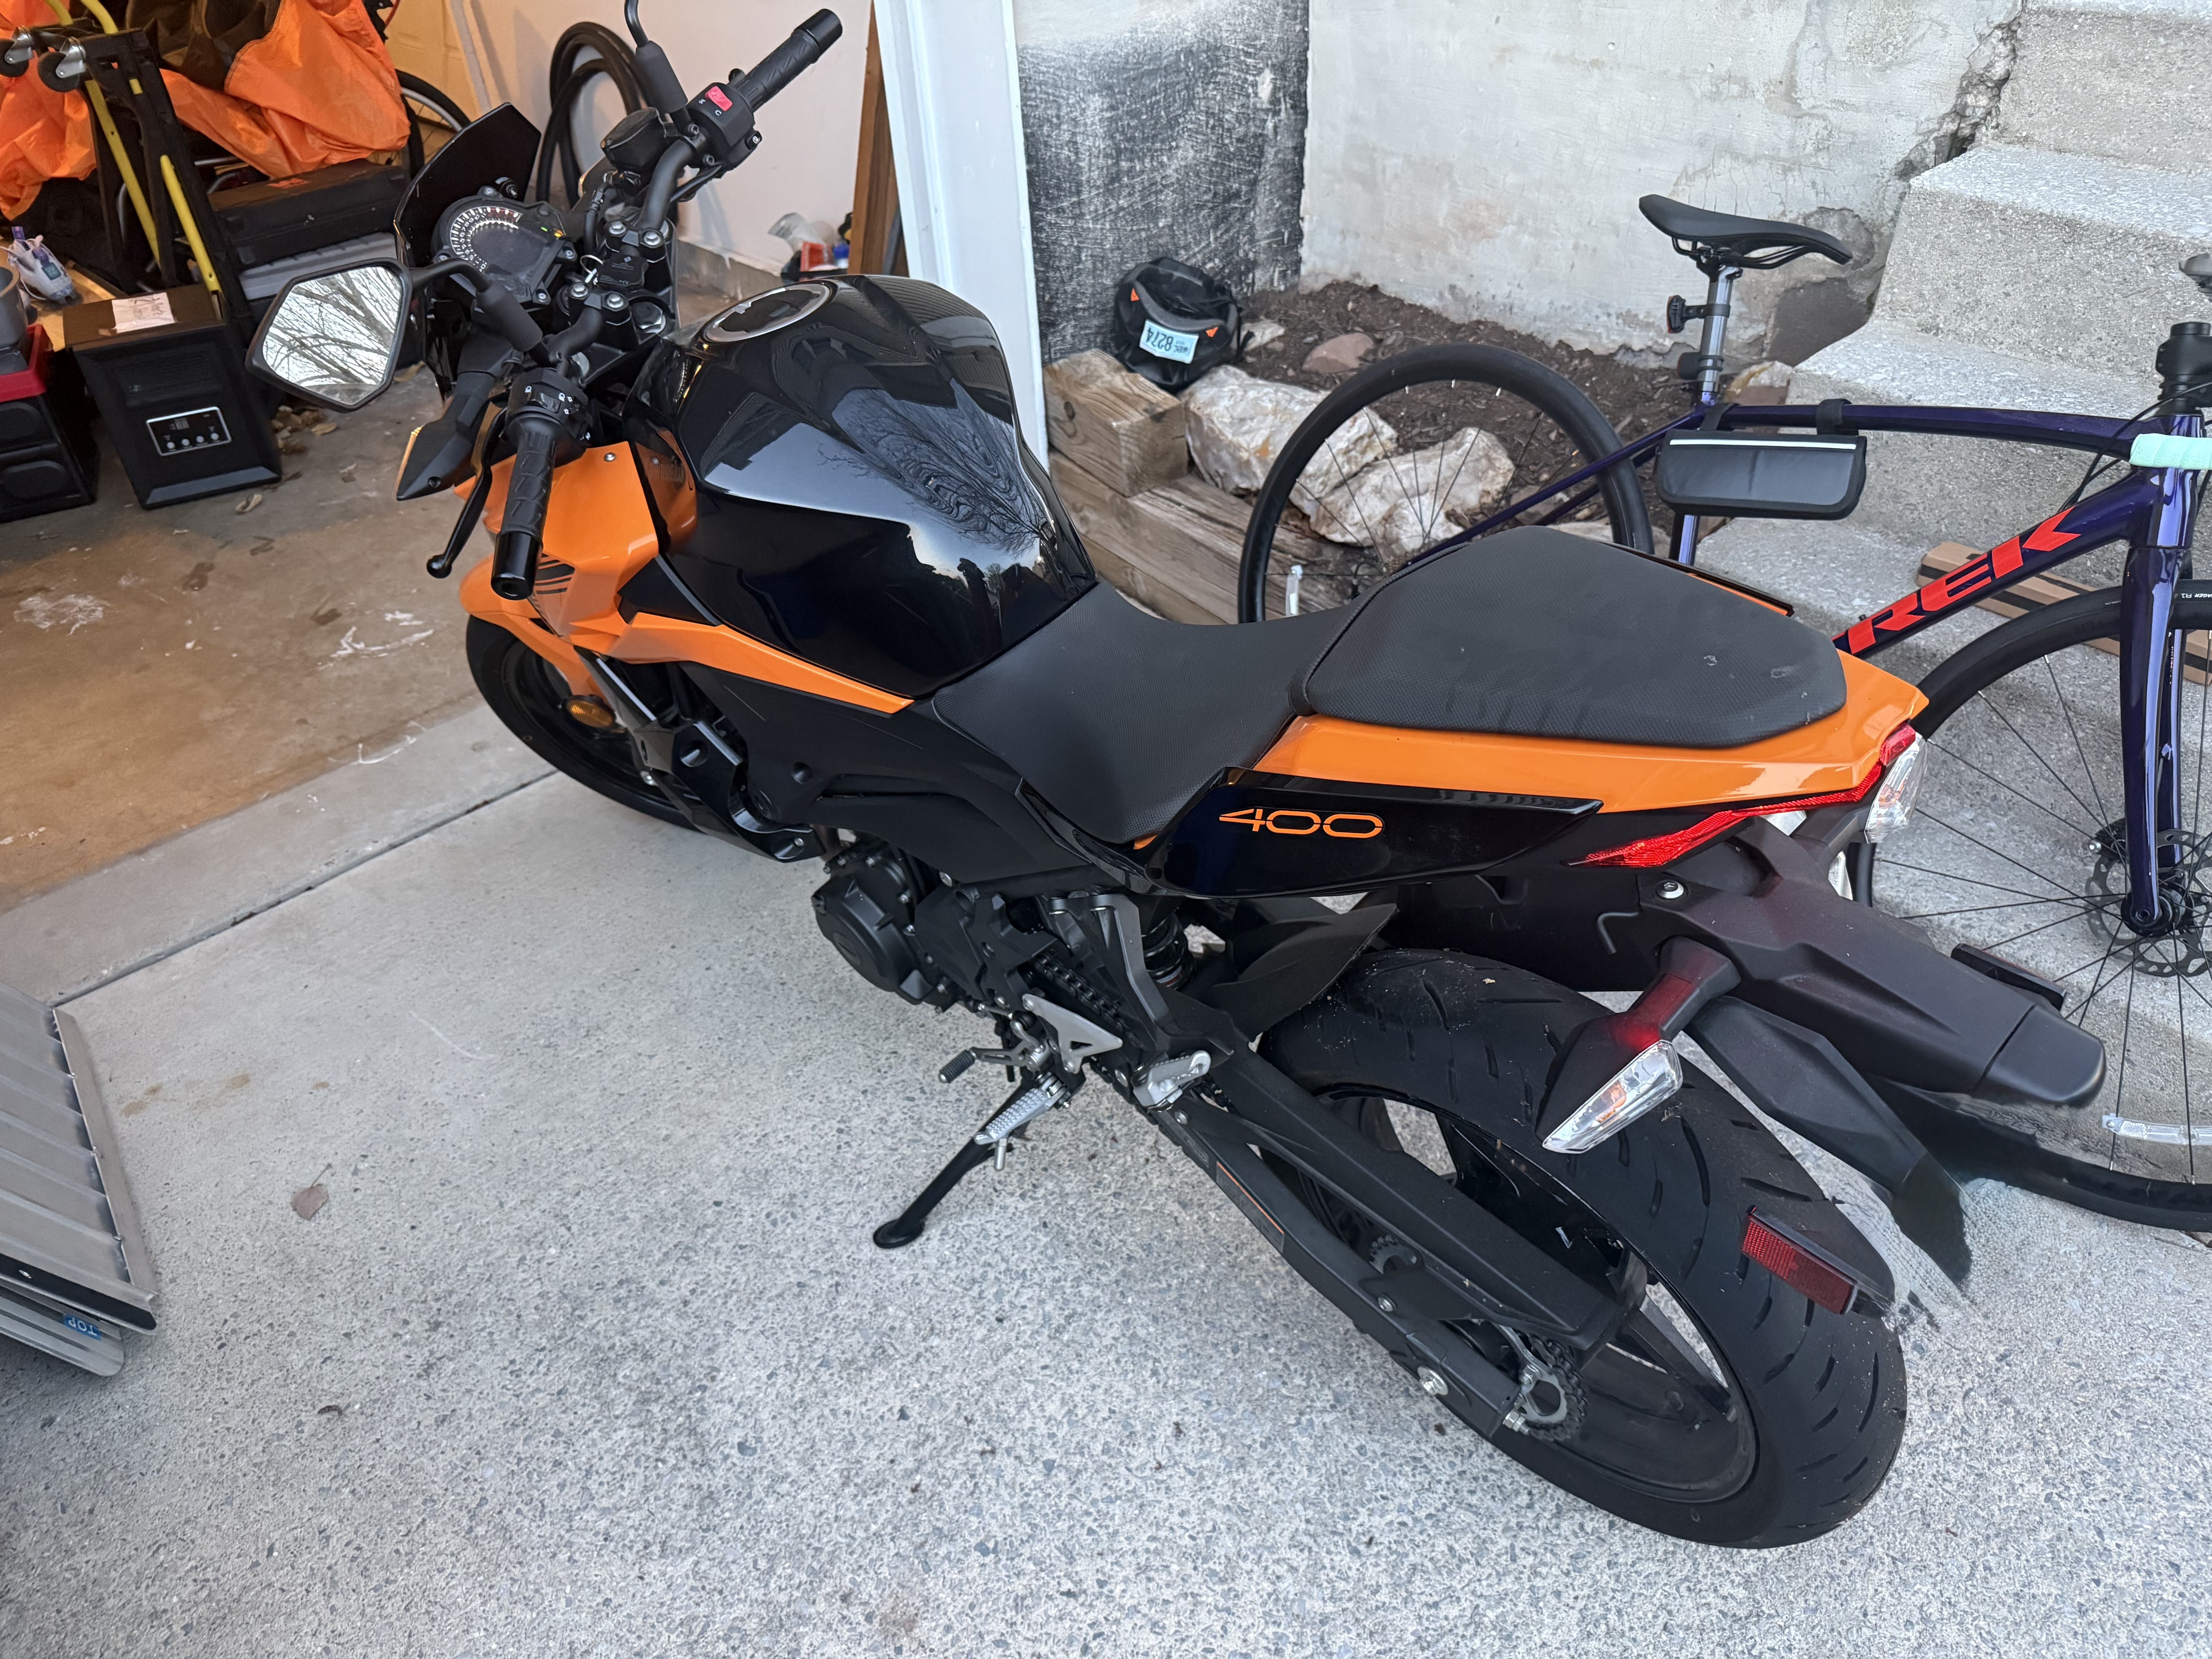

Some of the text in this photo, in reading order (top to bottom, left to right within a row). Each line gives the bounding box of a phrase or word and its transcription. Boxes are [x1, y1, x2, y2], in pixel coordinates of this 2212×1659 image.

[1146, 328, 1174, 352] 8274
[1831, 506, 2081, 654] REK
[1219, 808, 1383, 838] 400
[68, 1317, 98, 1336] TOP
